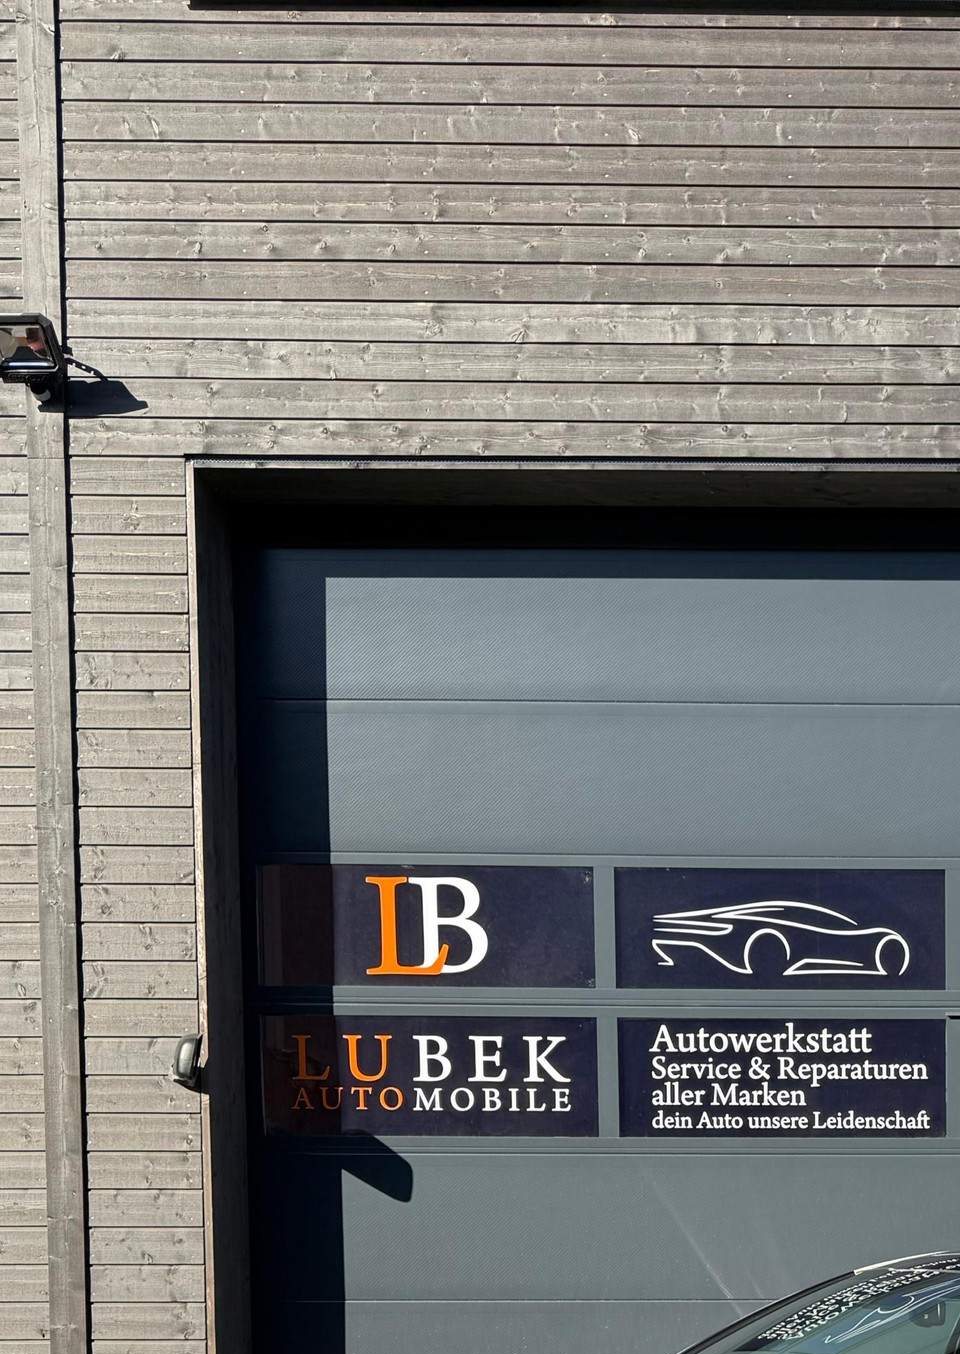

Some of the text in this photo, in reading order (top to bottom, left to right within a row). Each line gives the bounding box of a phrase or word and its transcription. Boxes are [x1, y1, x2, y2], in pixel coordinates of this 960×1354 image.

[365, 876, 489, 975] LB
[649, 1023, 873, 1053] Autowerkstatt
[291, 1034, 571, 1083] LUBEK
[651, 1056, 929, 1087] Service & Reparaturen
[291, 1086, 571, 1112] AUTOMOBILE
[651, 1081, 807, 1106] aller Marken
[651, 1110, 930, 1130] dein Auto unsere Leidenschaft
